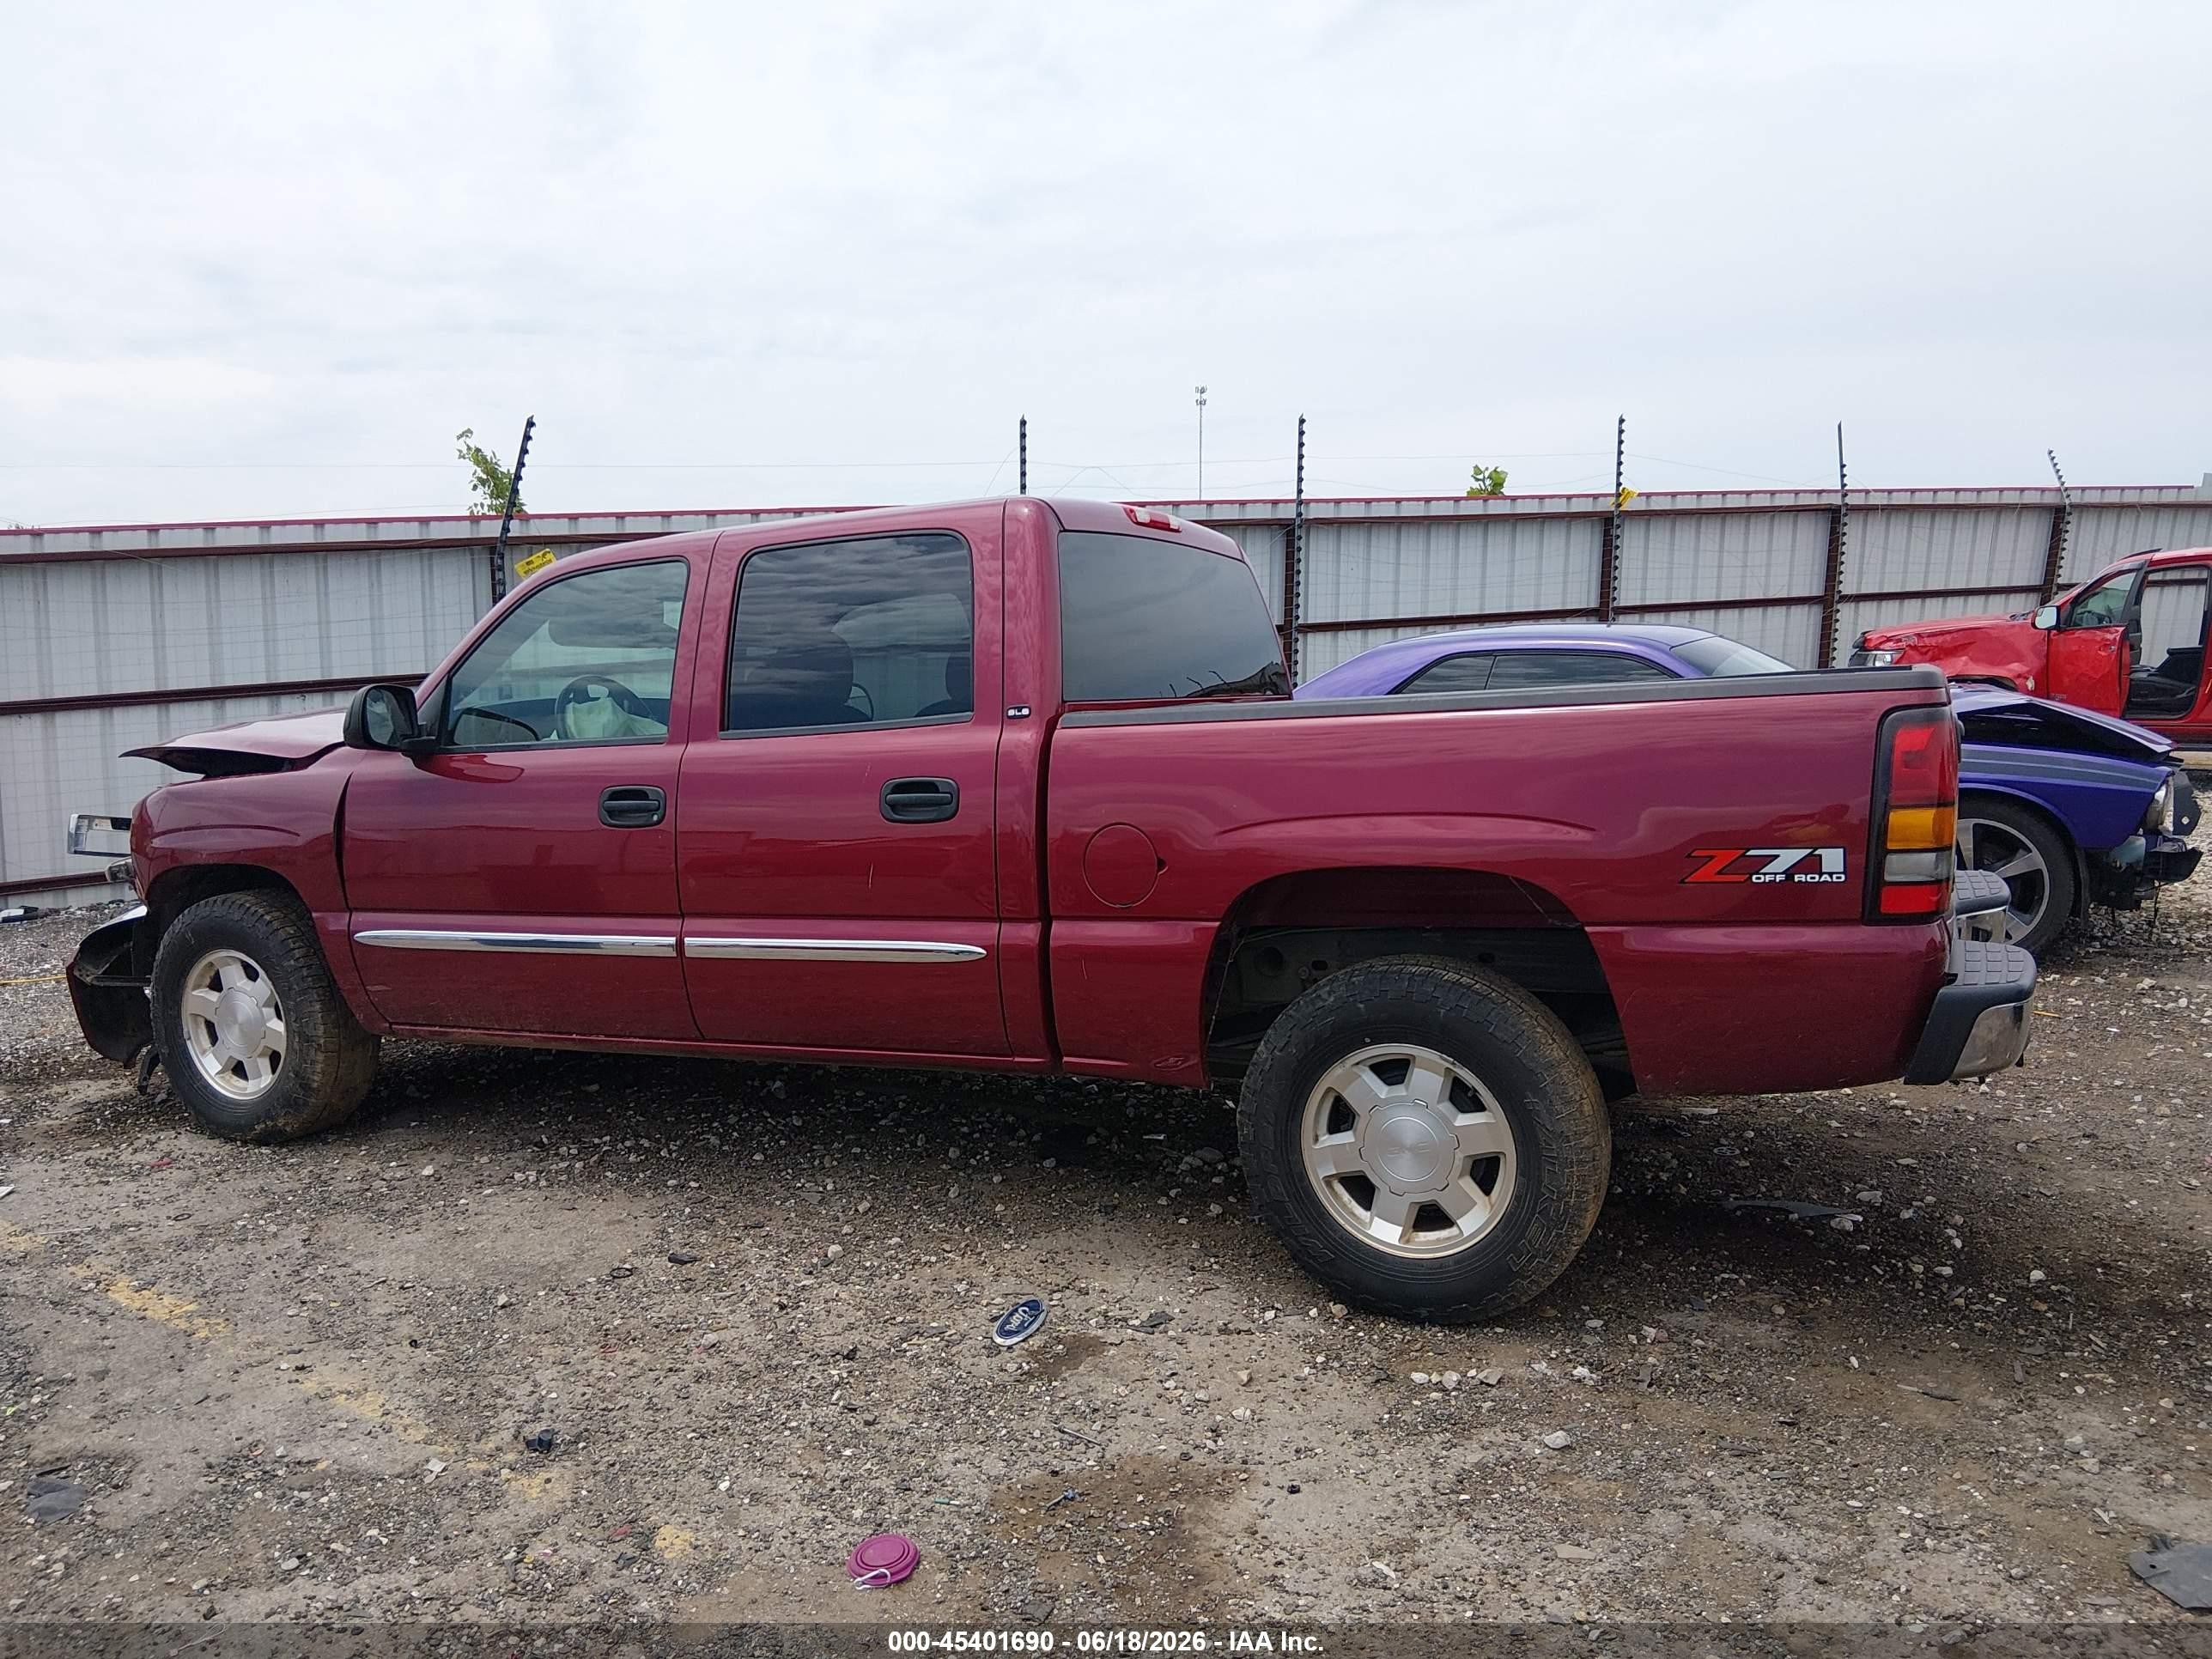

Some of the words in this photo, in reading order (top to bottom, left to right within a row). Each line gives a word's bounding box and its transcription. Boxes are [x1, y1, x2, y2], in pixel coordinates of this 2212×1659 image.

[1683, 848, 1844, 883] Z71
[1751, 873, 1786, 883] OFF
[1793, 872, 1846, 883] ROAD
[1003, 1306, 1036, 1332] Ford
